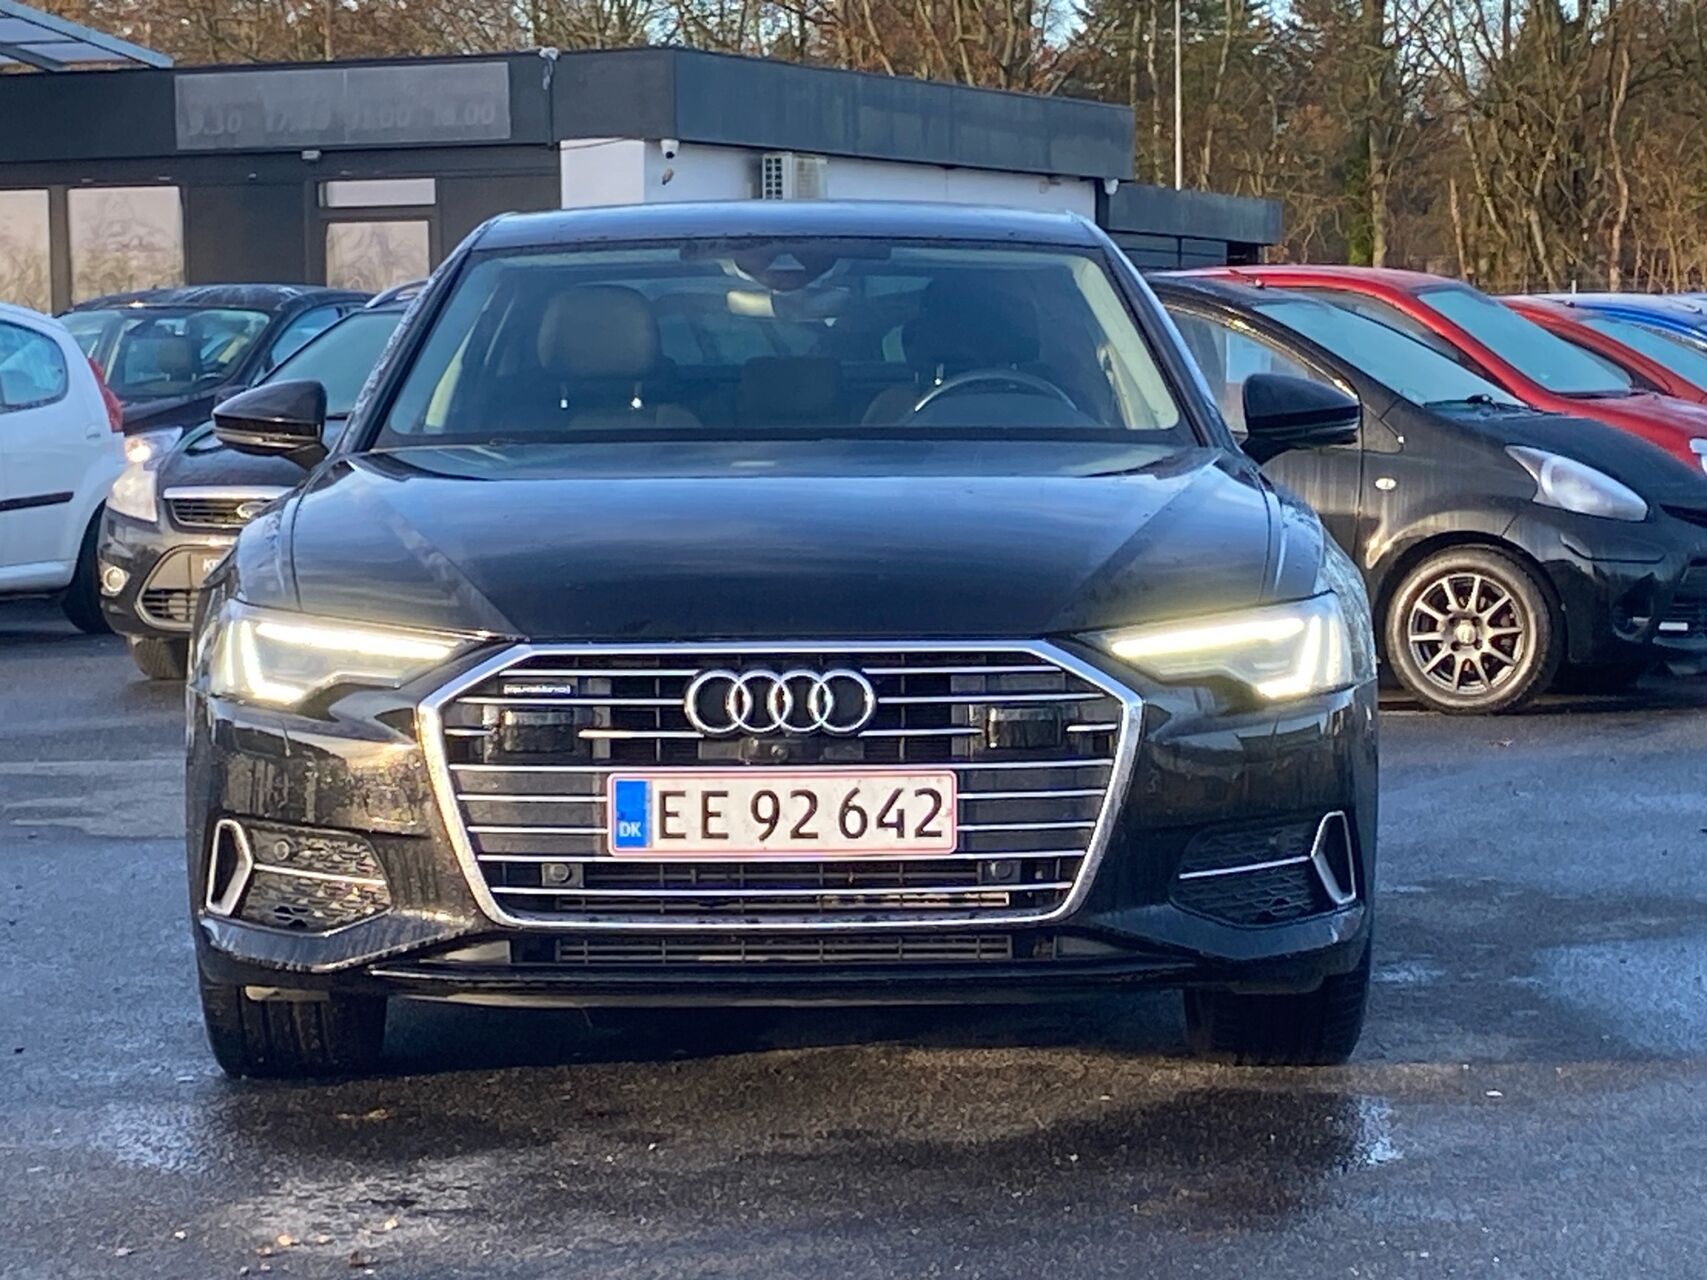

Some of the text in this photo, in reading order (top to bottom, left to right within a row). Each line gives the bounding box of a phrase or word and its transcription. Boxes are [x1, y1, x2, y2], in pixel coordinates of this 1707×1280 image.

[619, 822, 642, 838] DK
[659, 787, 943, 842] EE 92 642
